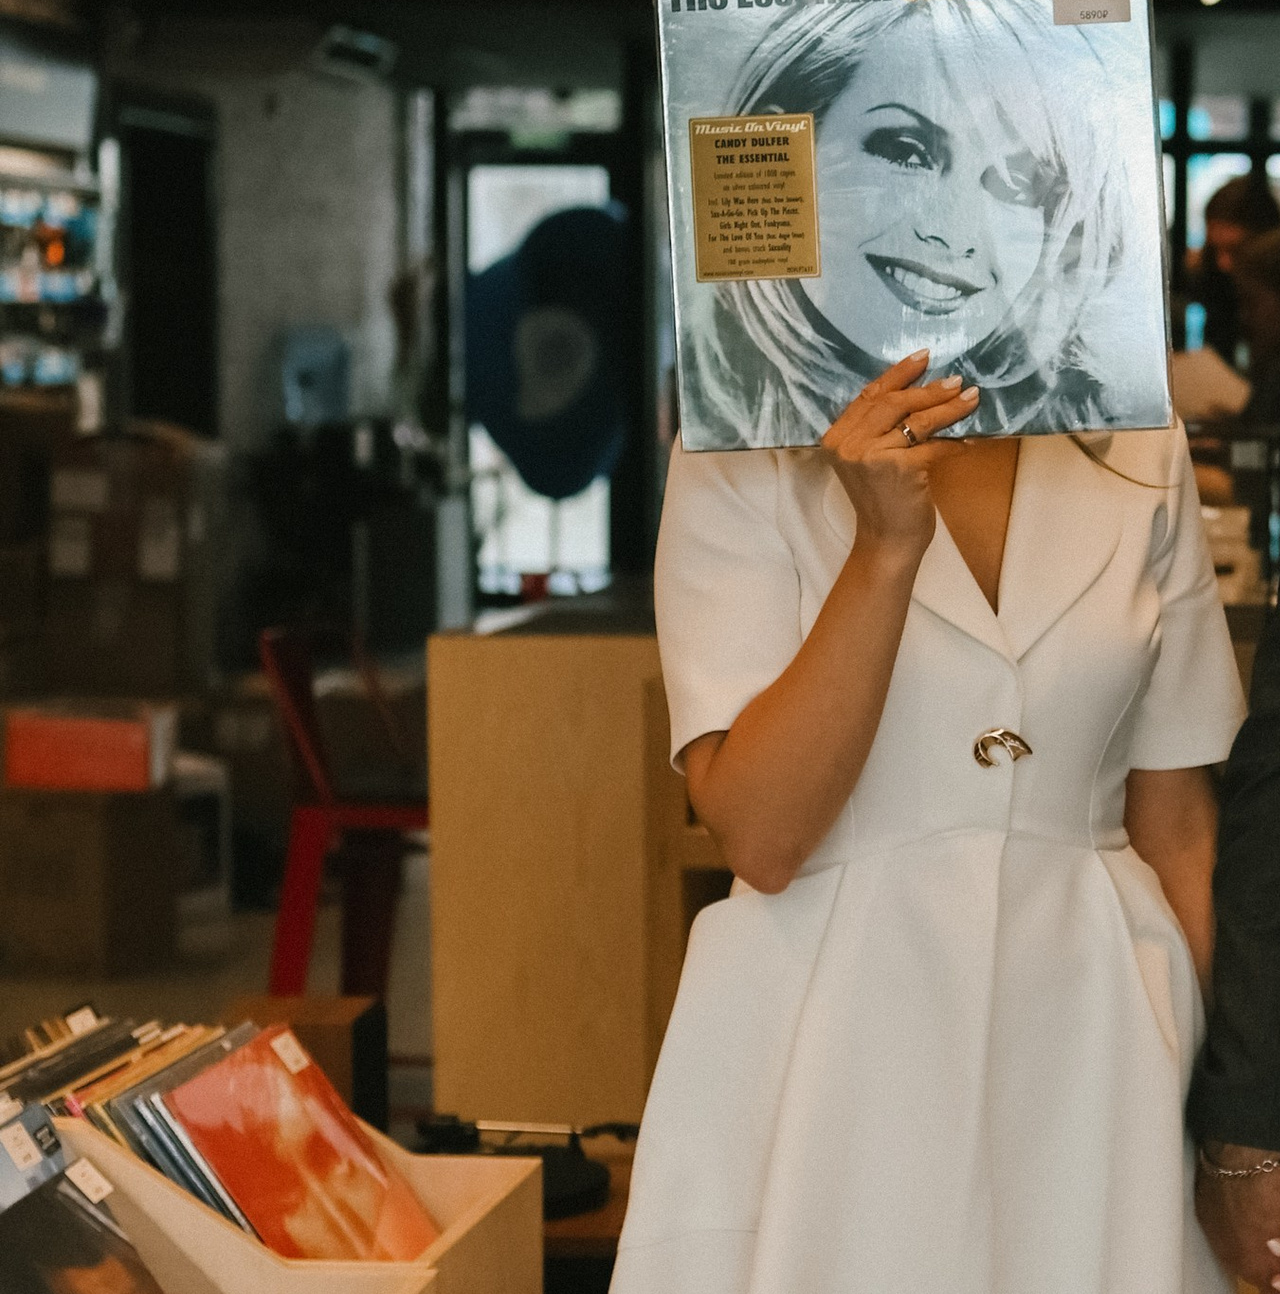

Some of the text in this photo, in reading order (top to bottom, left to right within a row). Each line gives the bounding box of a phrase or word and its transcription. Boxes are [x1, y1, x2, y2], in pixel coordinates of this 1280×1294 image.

[694, 120, 808, 135] Music On Vinyl
[714, 136, 790, 149] CANDY DULFER
[716, 152, 790, 164] THE ESSENTIAL
